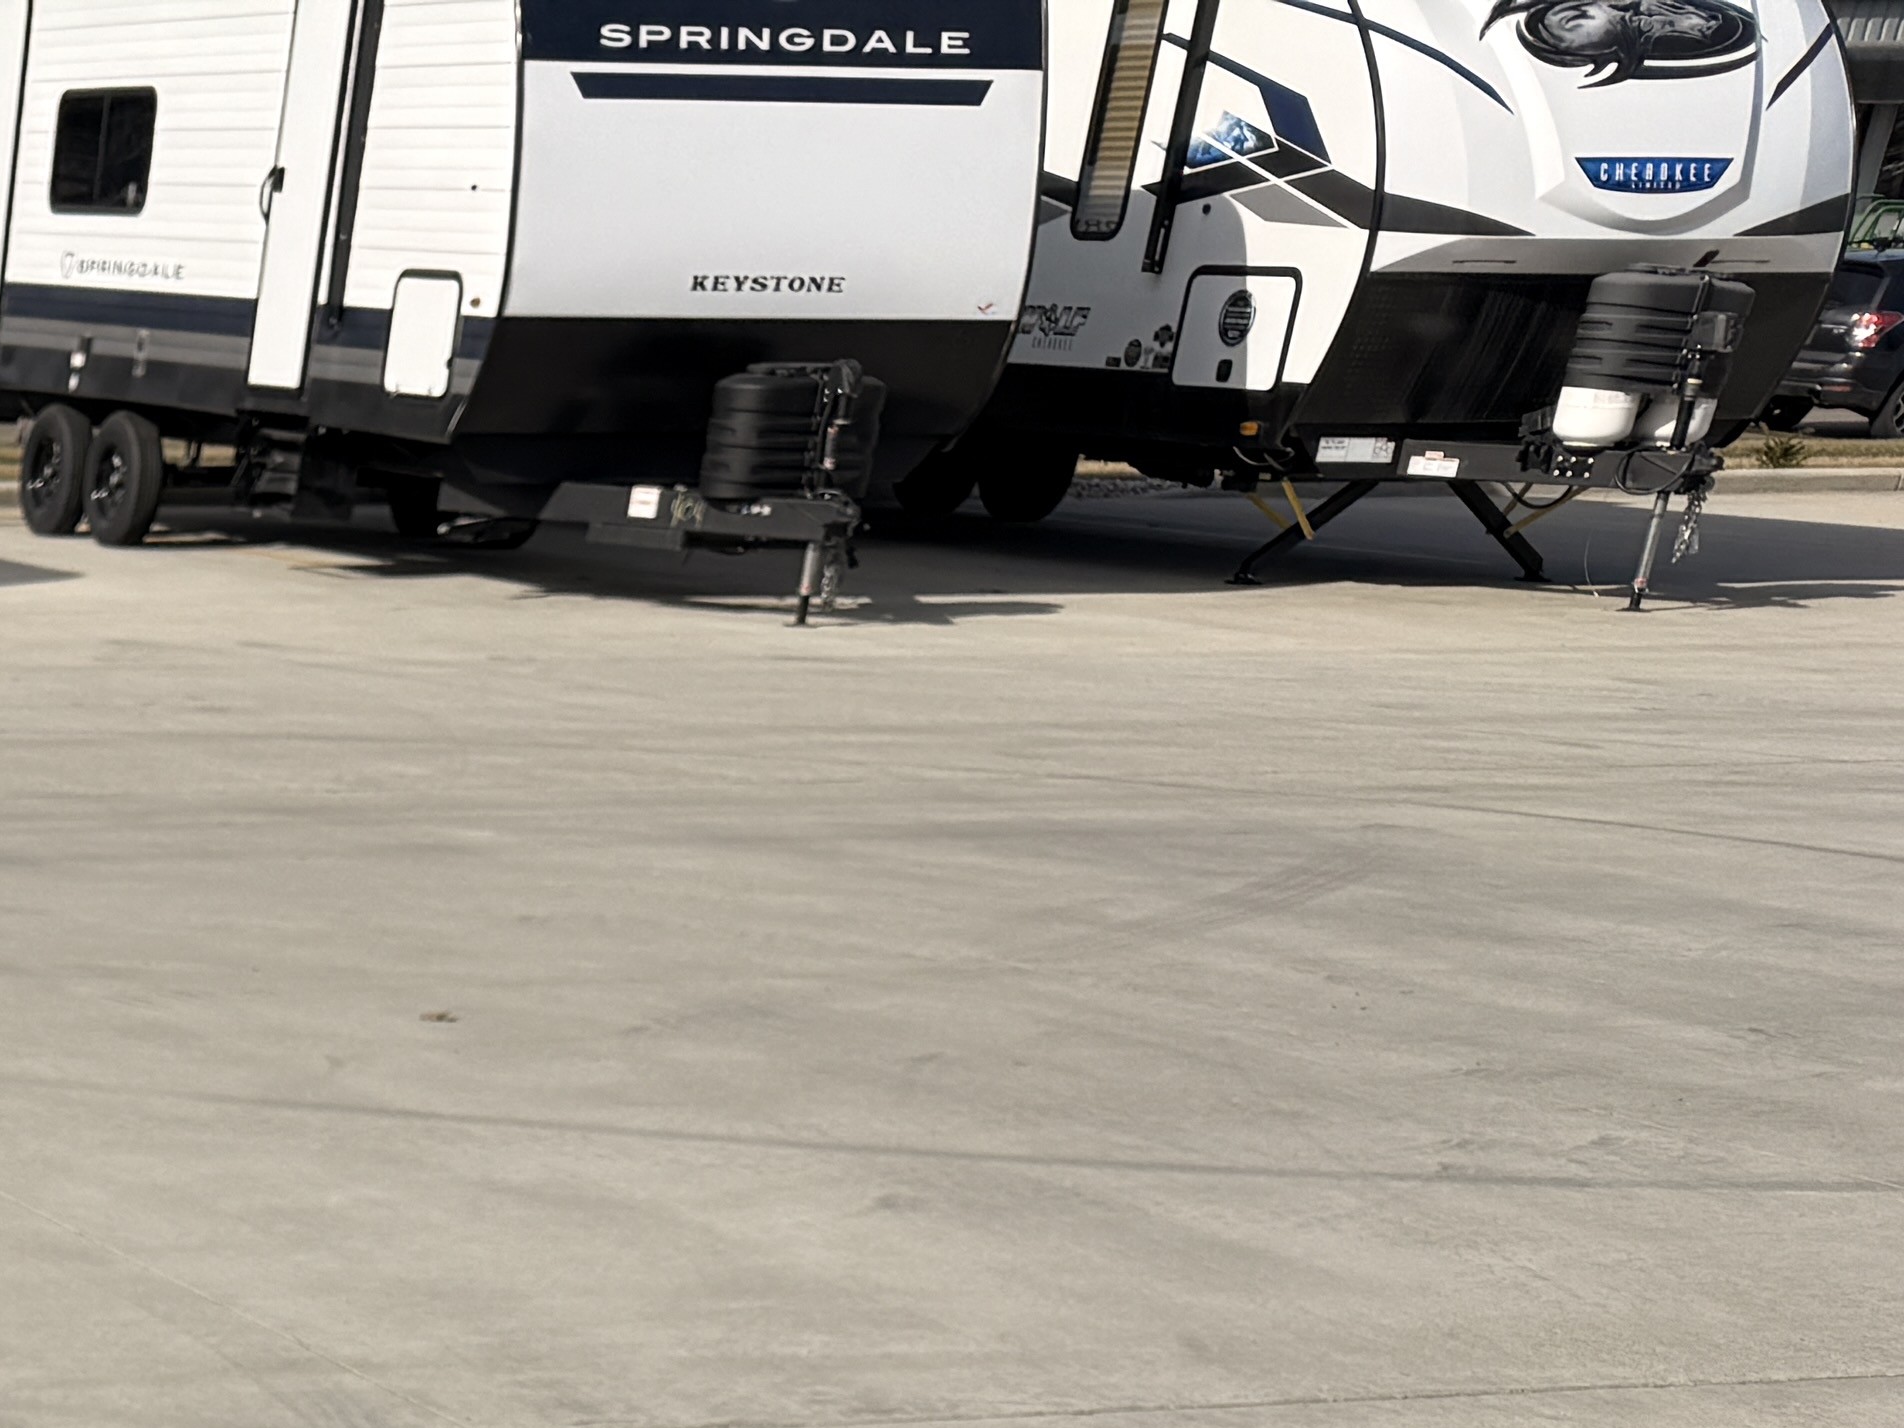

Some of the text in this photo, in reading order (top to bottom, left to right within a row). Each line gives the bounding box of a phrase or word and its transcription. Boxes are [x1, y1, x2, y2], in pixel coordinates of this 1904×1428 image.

[599, 22, 972, 56] SPRINGDALE
[1599, 162, 1713, 182] CHEROKEE
[689, 275, 847, 295] KEYSTONE
